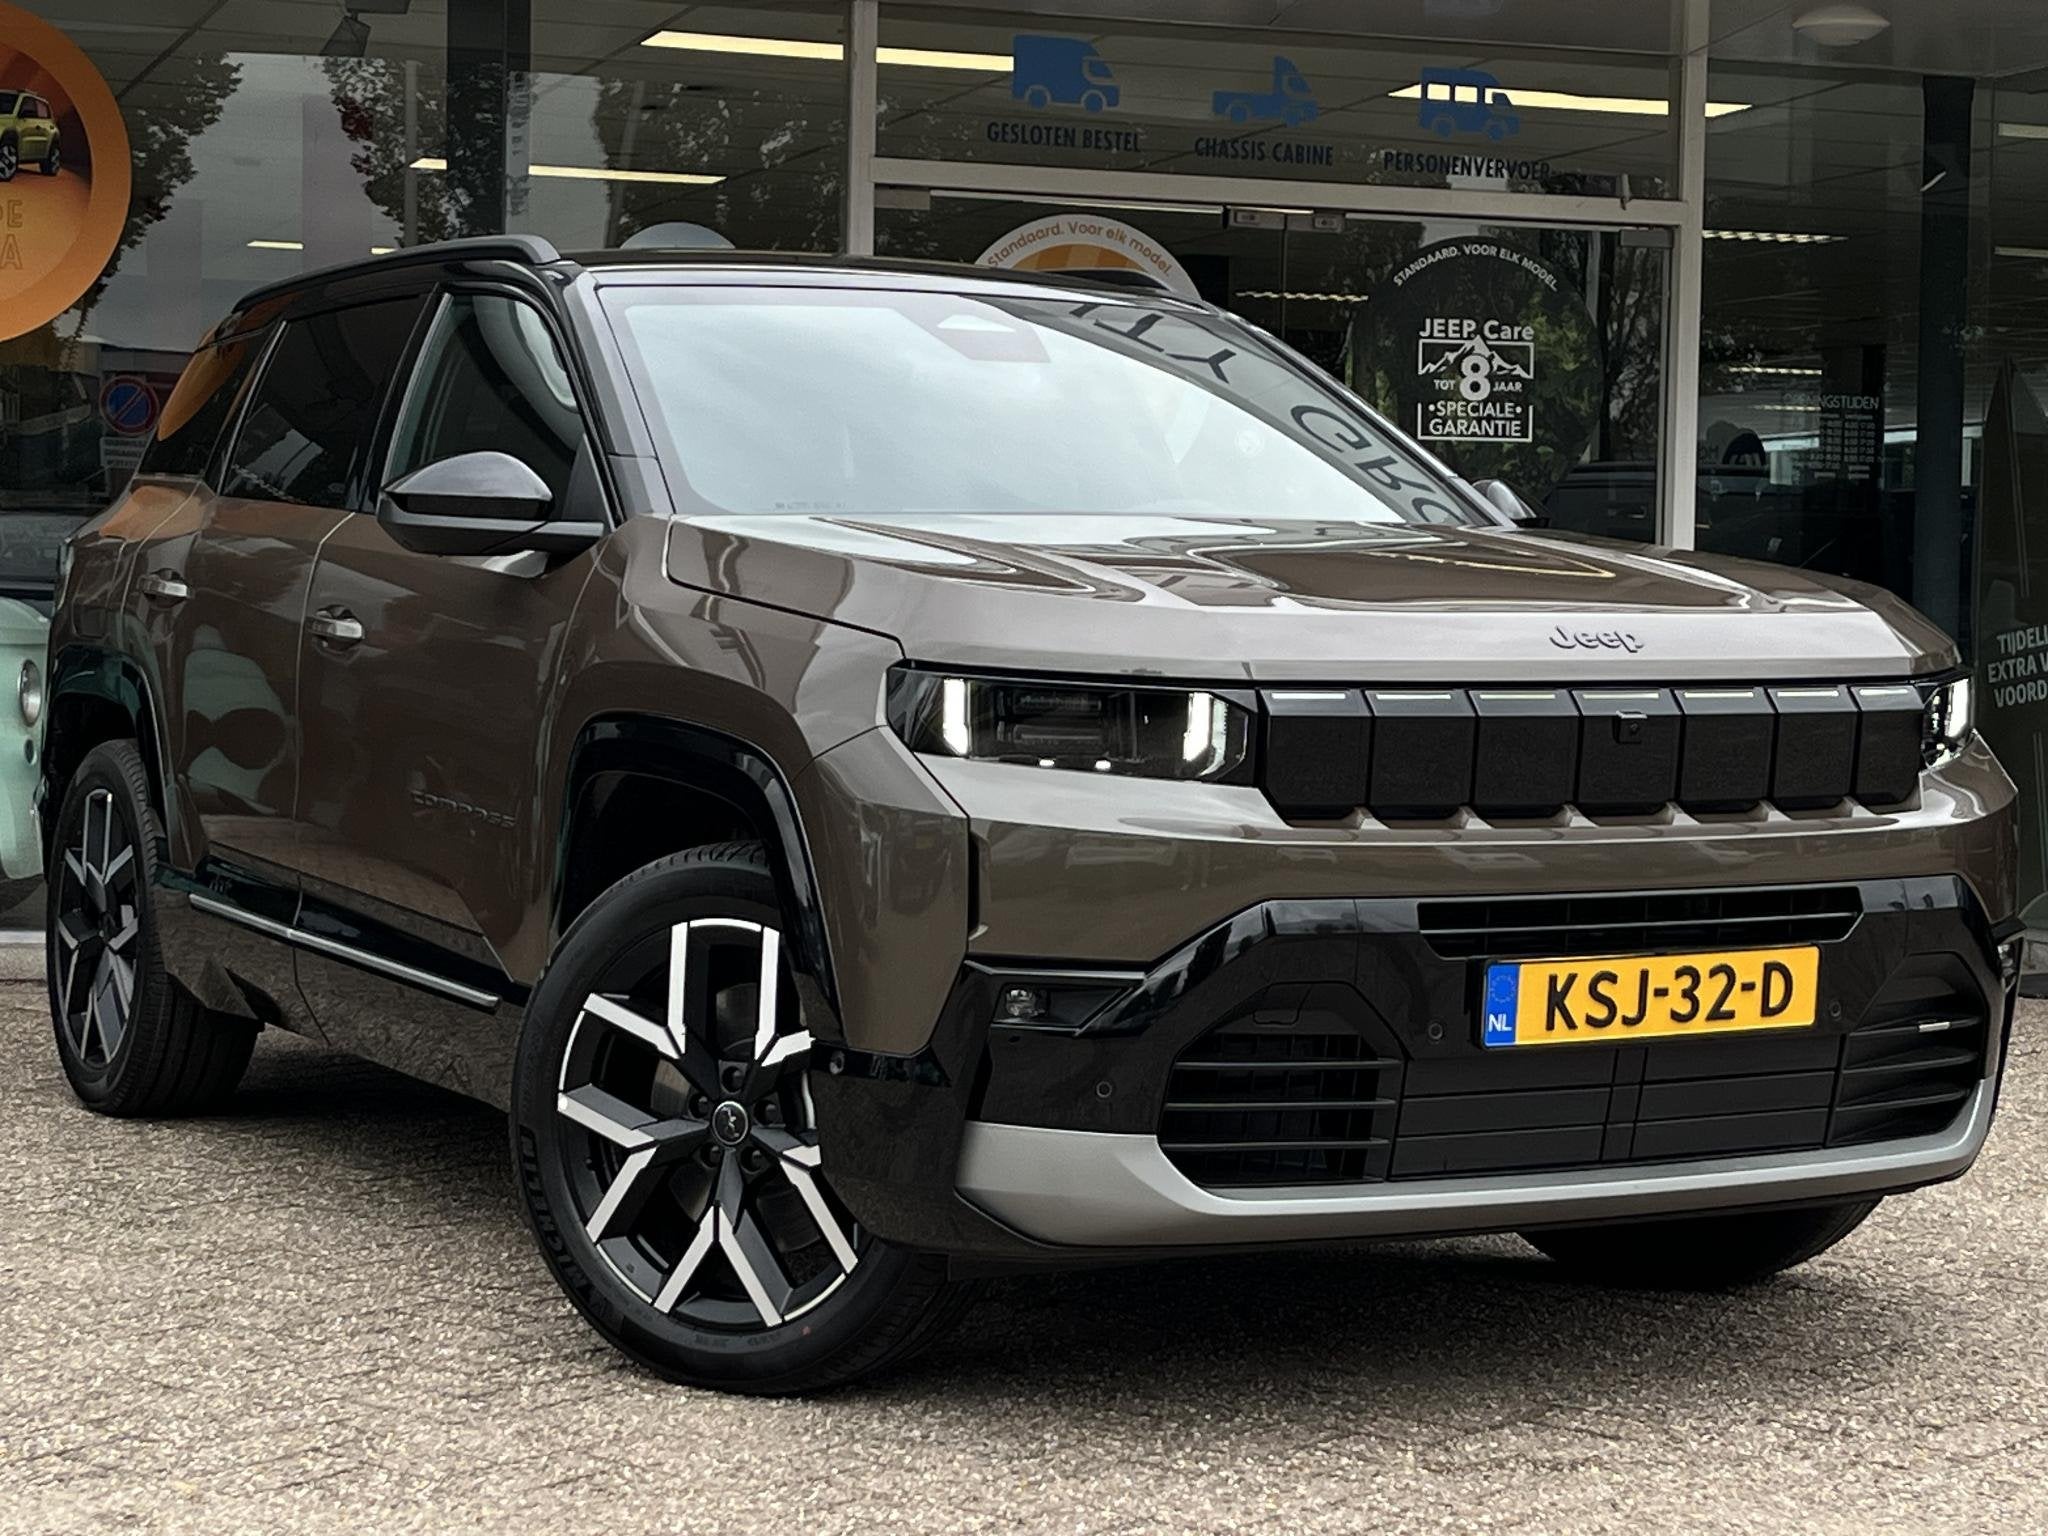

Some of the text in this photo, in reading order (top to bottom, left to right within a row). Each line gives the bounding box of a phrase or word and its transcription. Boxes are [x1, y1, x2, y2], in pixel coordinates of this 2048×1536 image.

[987, 122, 1142, 153] GESLOTEN BESTEL
[1194, 137, 1334, 166] CHASSIS CABINE
[1383, 151, 1550, 181] PERSONENVERVOER
[0, 199, 23, 228] E
[987, 221, 1173, 277] Standaard. Voor elk model.
[1463, 244, 1498, 257] VOOR
[1499, 249, 1521, 264] ELK
[1483, 320, 1535, 340] Care
[1434, 354, 1522, 401] TOT 8 JAAR
[1429, 418, 1521, 436] GARANTIE
[1549, 625, 1645, 654] Jeep
[1987, 654, 2038, 683] EXTRA
[1545, 960, 1793, 1032] KSJ-32-D
[1487, 1013, 1513, 1033] NL
